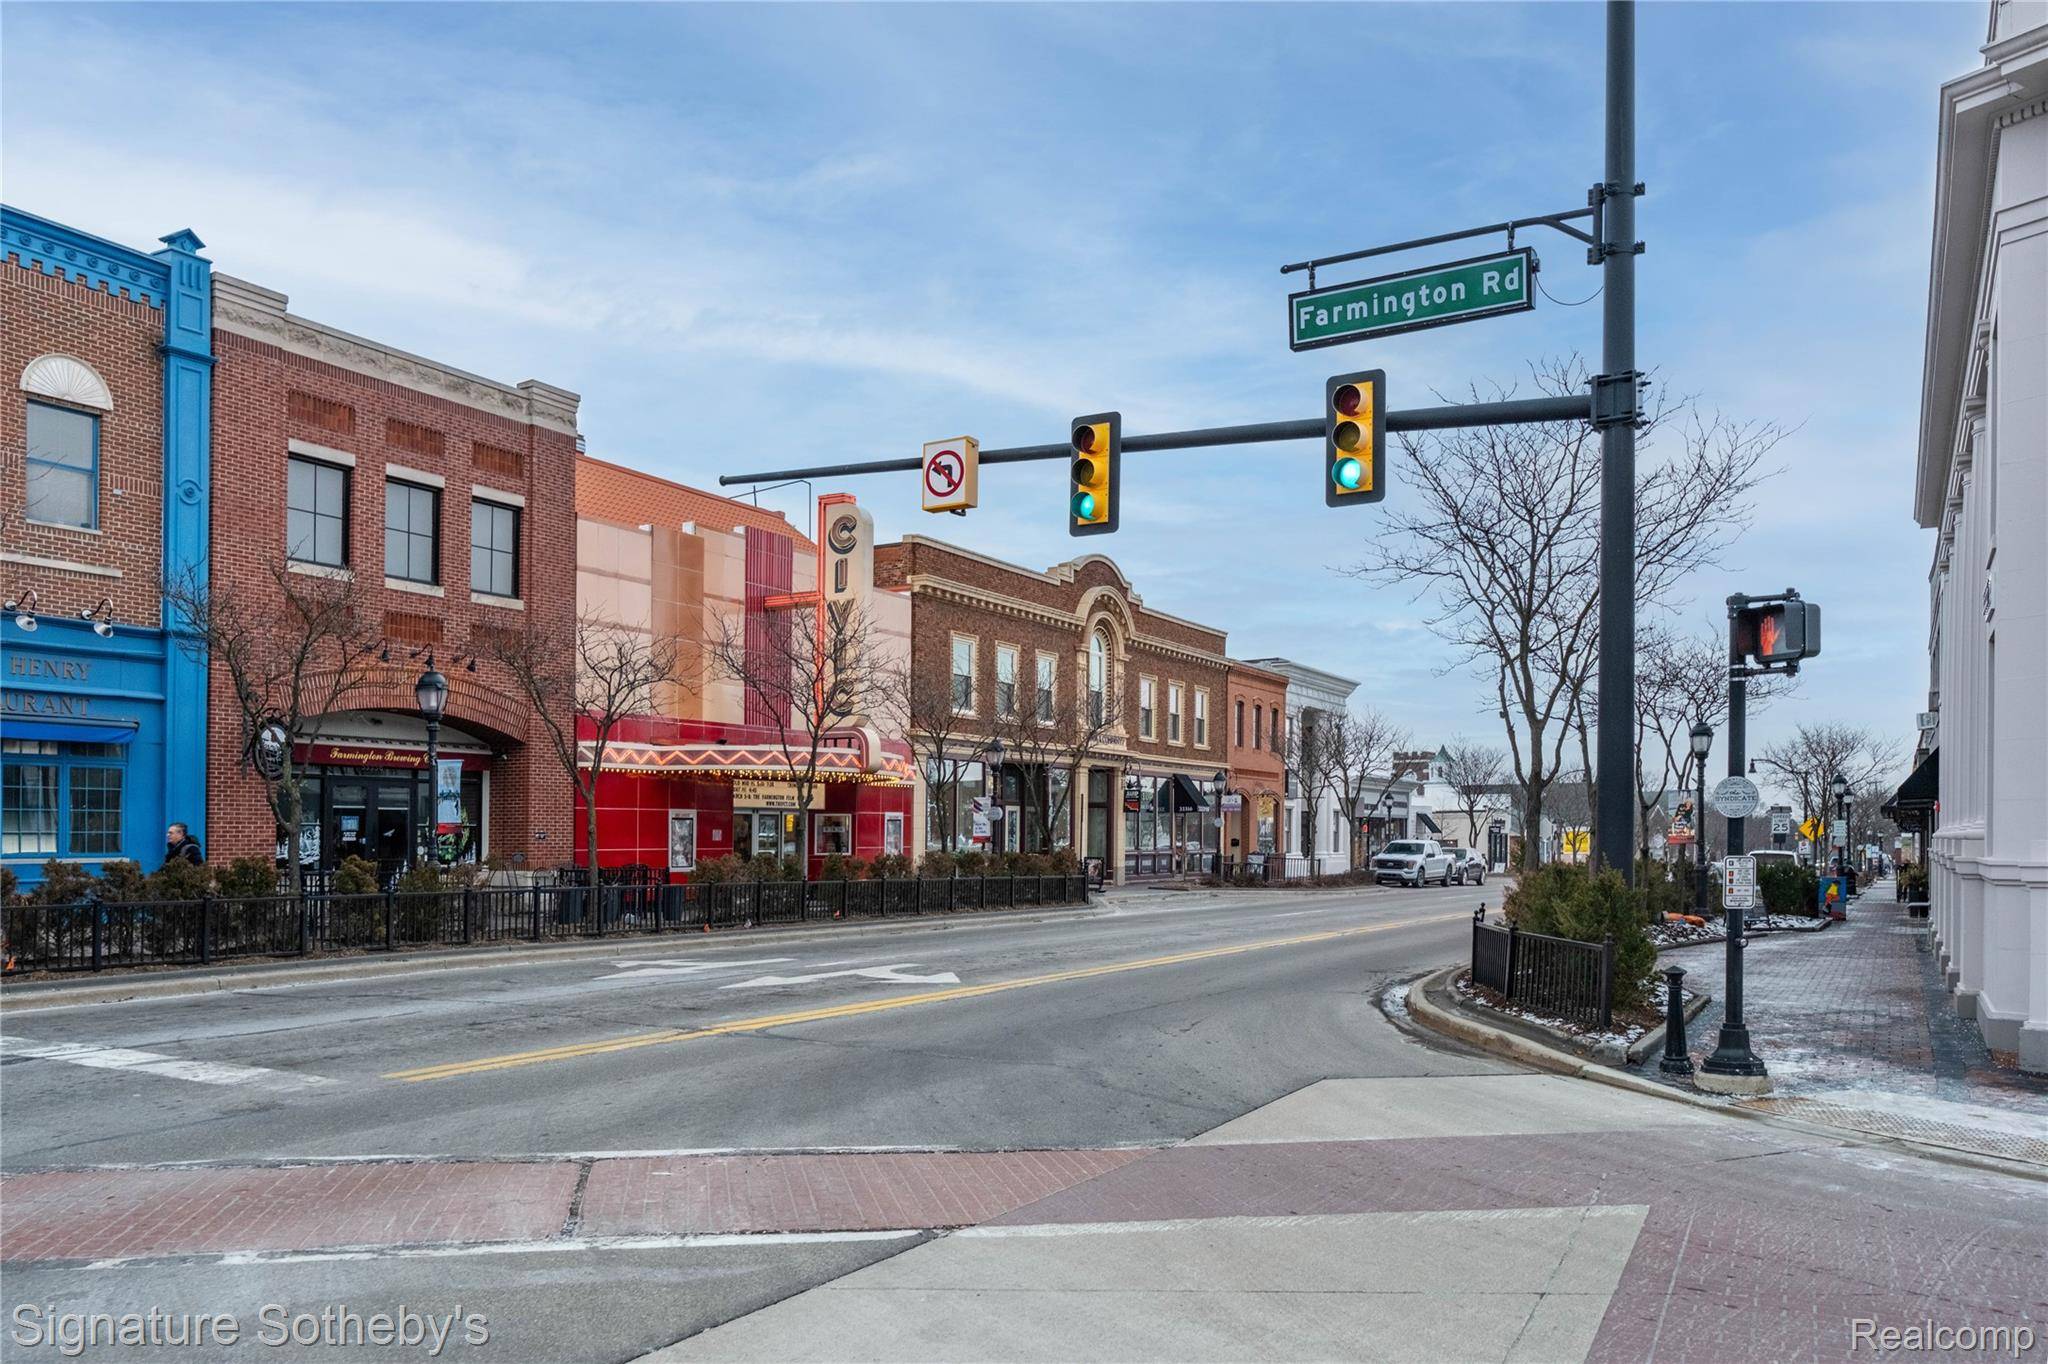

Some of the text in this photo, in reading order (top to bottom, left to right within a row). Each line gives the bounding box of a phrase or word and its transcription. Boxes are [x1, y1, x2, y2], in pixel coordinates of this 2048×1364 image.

[1300, 266, 1519, 330] Farmington Rd
[828, 513, 857, 717] CIVIC
[10, 656, 92, 681] HENRY
[329, 747, 382, 763] Farmington
[383, 750, 421, 766] Brewing
[1773, 823, 1789, 832] 25
